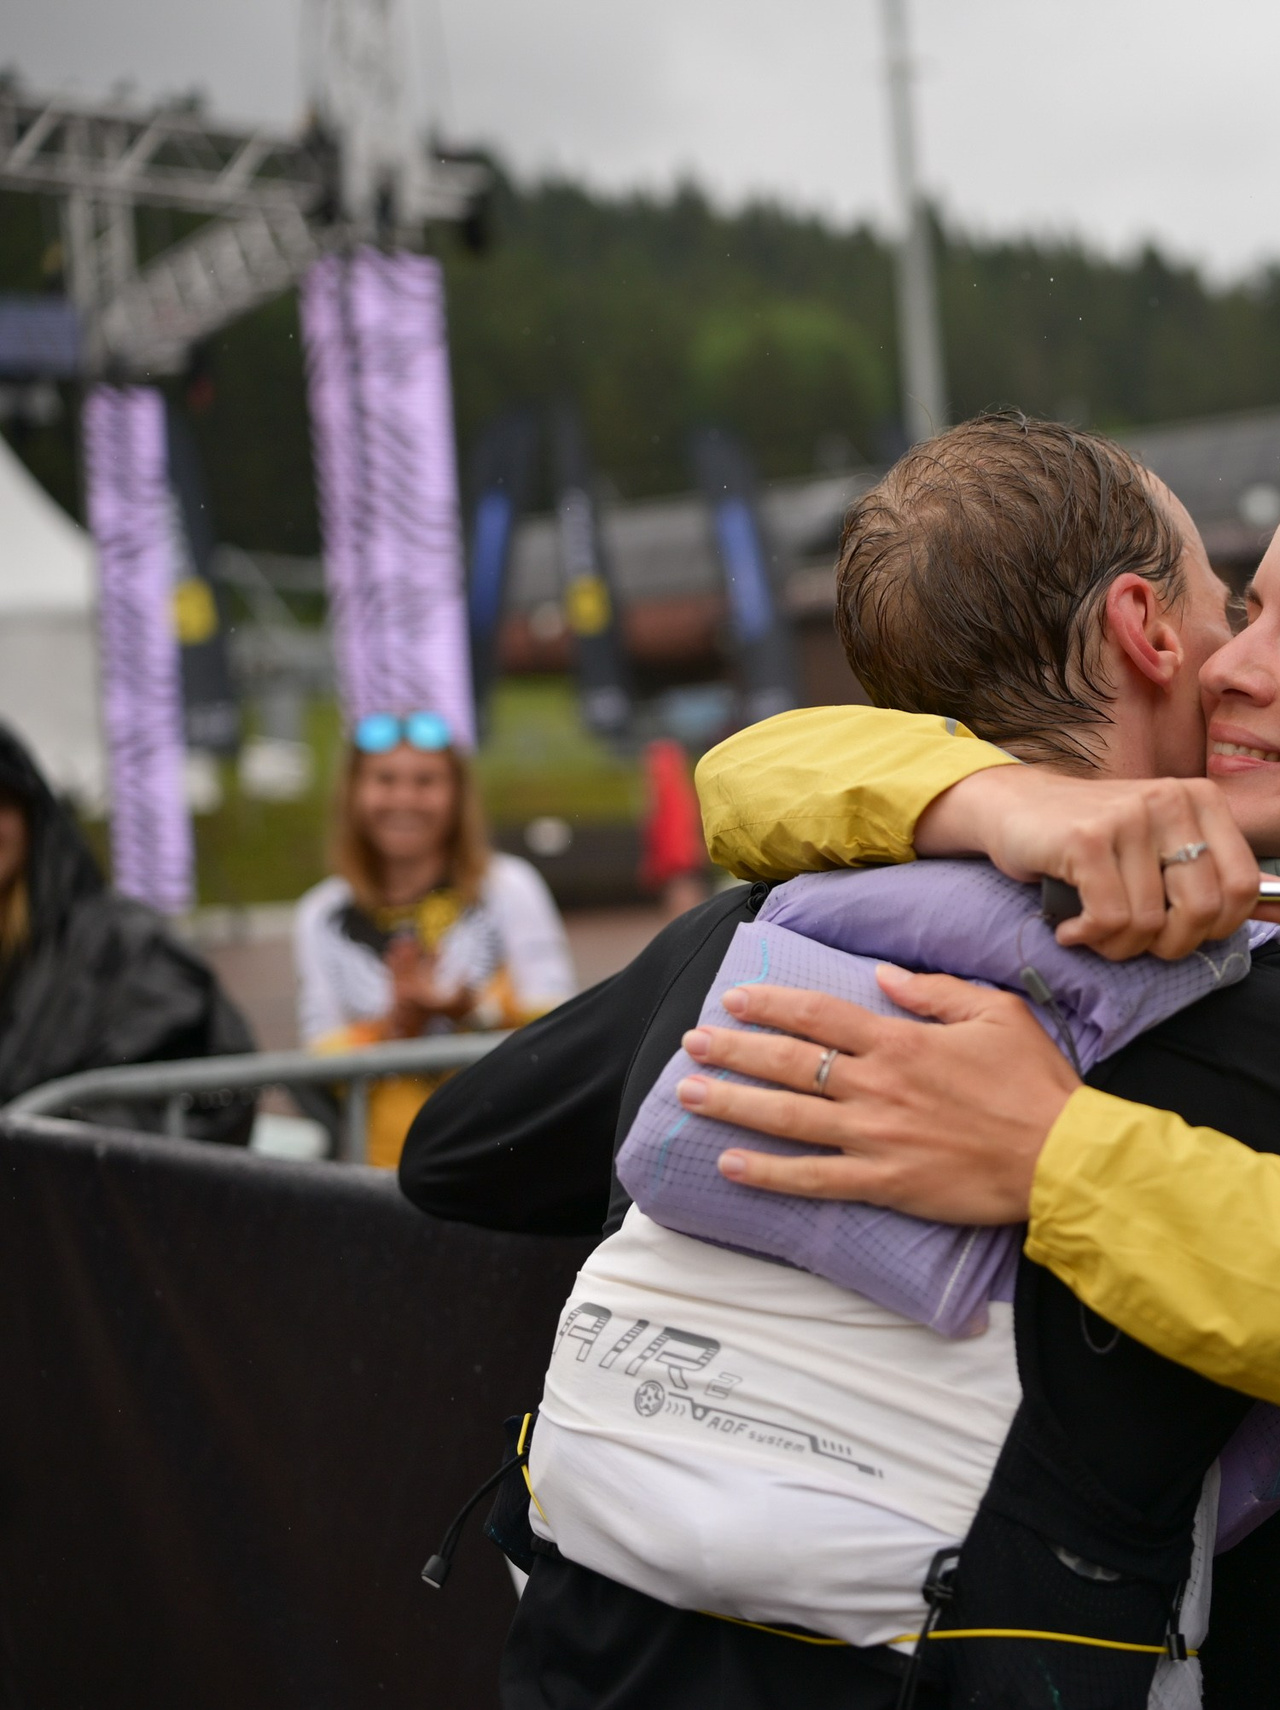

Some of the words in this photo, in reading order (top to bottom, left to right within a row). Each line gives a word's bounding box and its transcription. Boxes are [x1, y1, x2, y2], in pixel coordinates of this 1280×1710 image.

[553, 1302, 720, 1390] AIR
[707, 1416, 748, 1435] ADF
[748, 1430, 805, 1452] system
